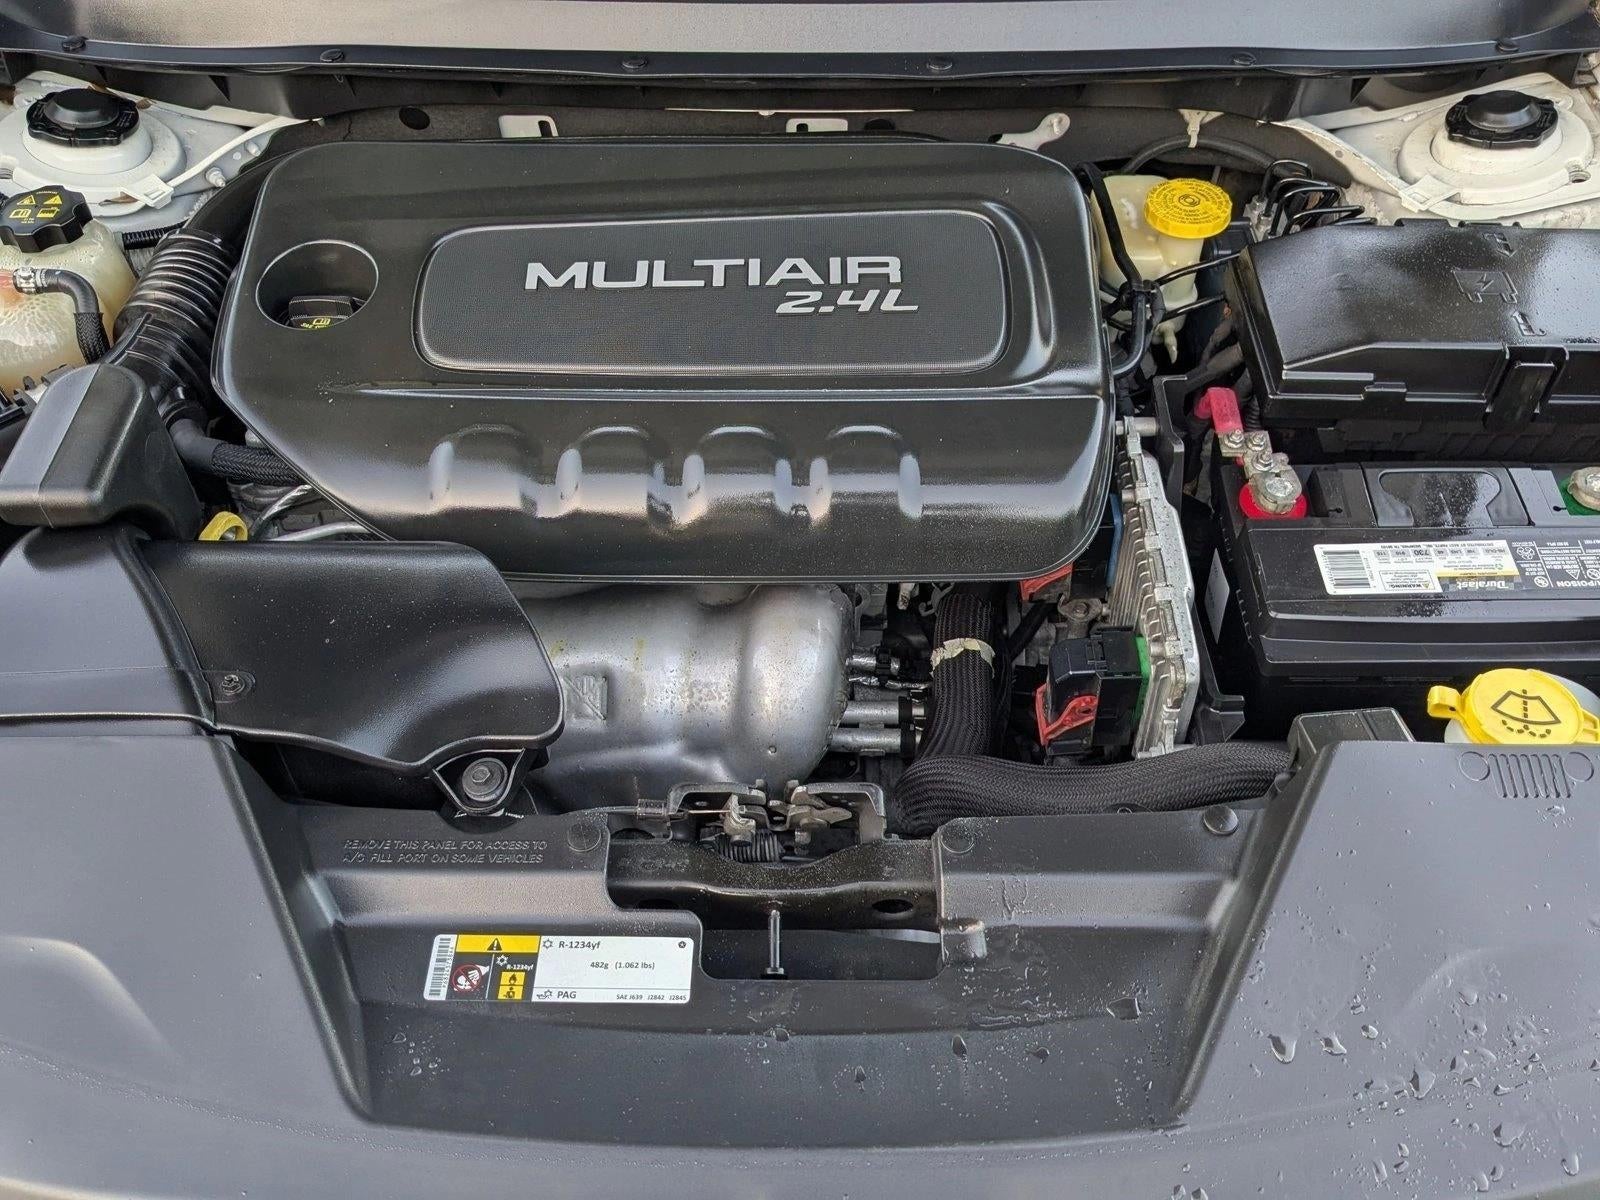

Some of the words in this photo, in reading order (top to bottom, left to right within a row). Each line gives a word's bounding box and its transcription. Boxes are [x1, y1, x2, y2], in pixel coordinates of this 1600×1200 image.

[525, 255, 902, 290] MULTIAIR
[775, 288, 919, 315] 2.4L
[1456, 580, 1509, 590] Duralast
[344, 840, 391, 850] REMOVE
[394, 840, 420, 850] THIS
[422, 840, 457, 850] PANEL
[460, 840, 484, 850] FOR
[486, 840, 530, 850] ACCESS
[532, 840, 548, 850] TO
[342, 853, 365, 864] A/C
[370, 853, 393, 864] FILL
[397, 853, 427, 864] PORT
[431, 853, 449, 864] ON
[451, 853, 484, 864] SOME
[488, 853, 544, 864] VEHICLES
[558, 940, 601, 950] R-1234yf
[590, 962, 609, 970] 482g
[615, 962, 640, 970] (1.062
[641, 962, 655, 970] lbs)
[557, 990, 577, 1000] PAG
